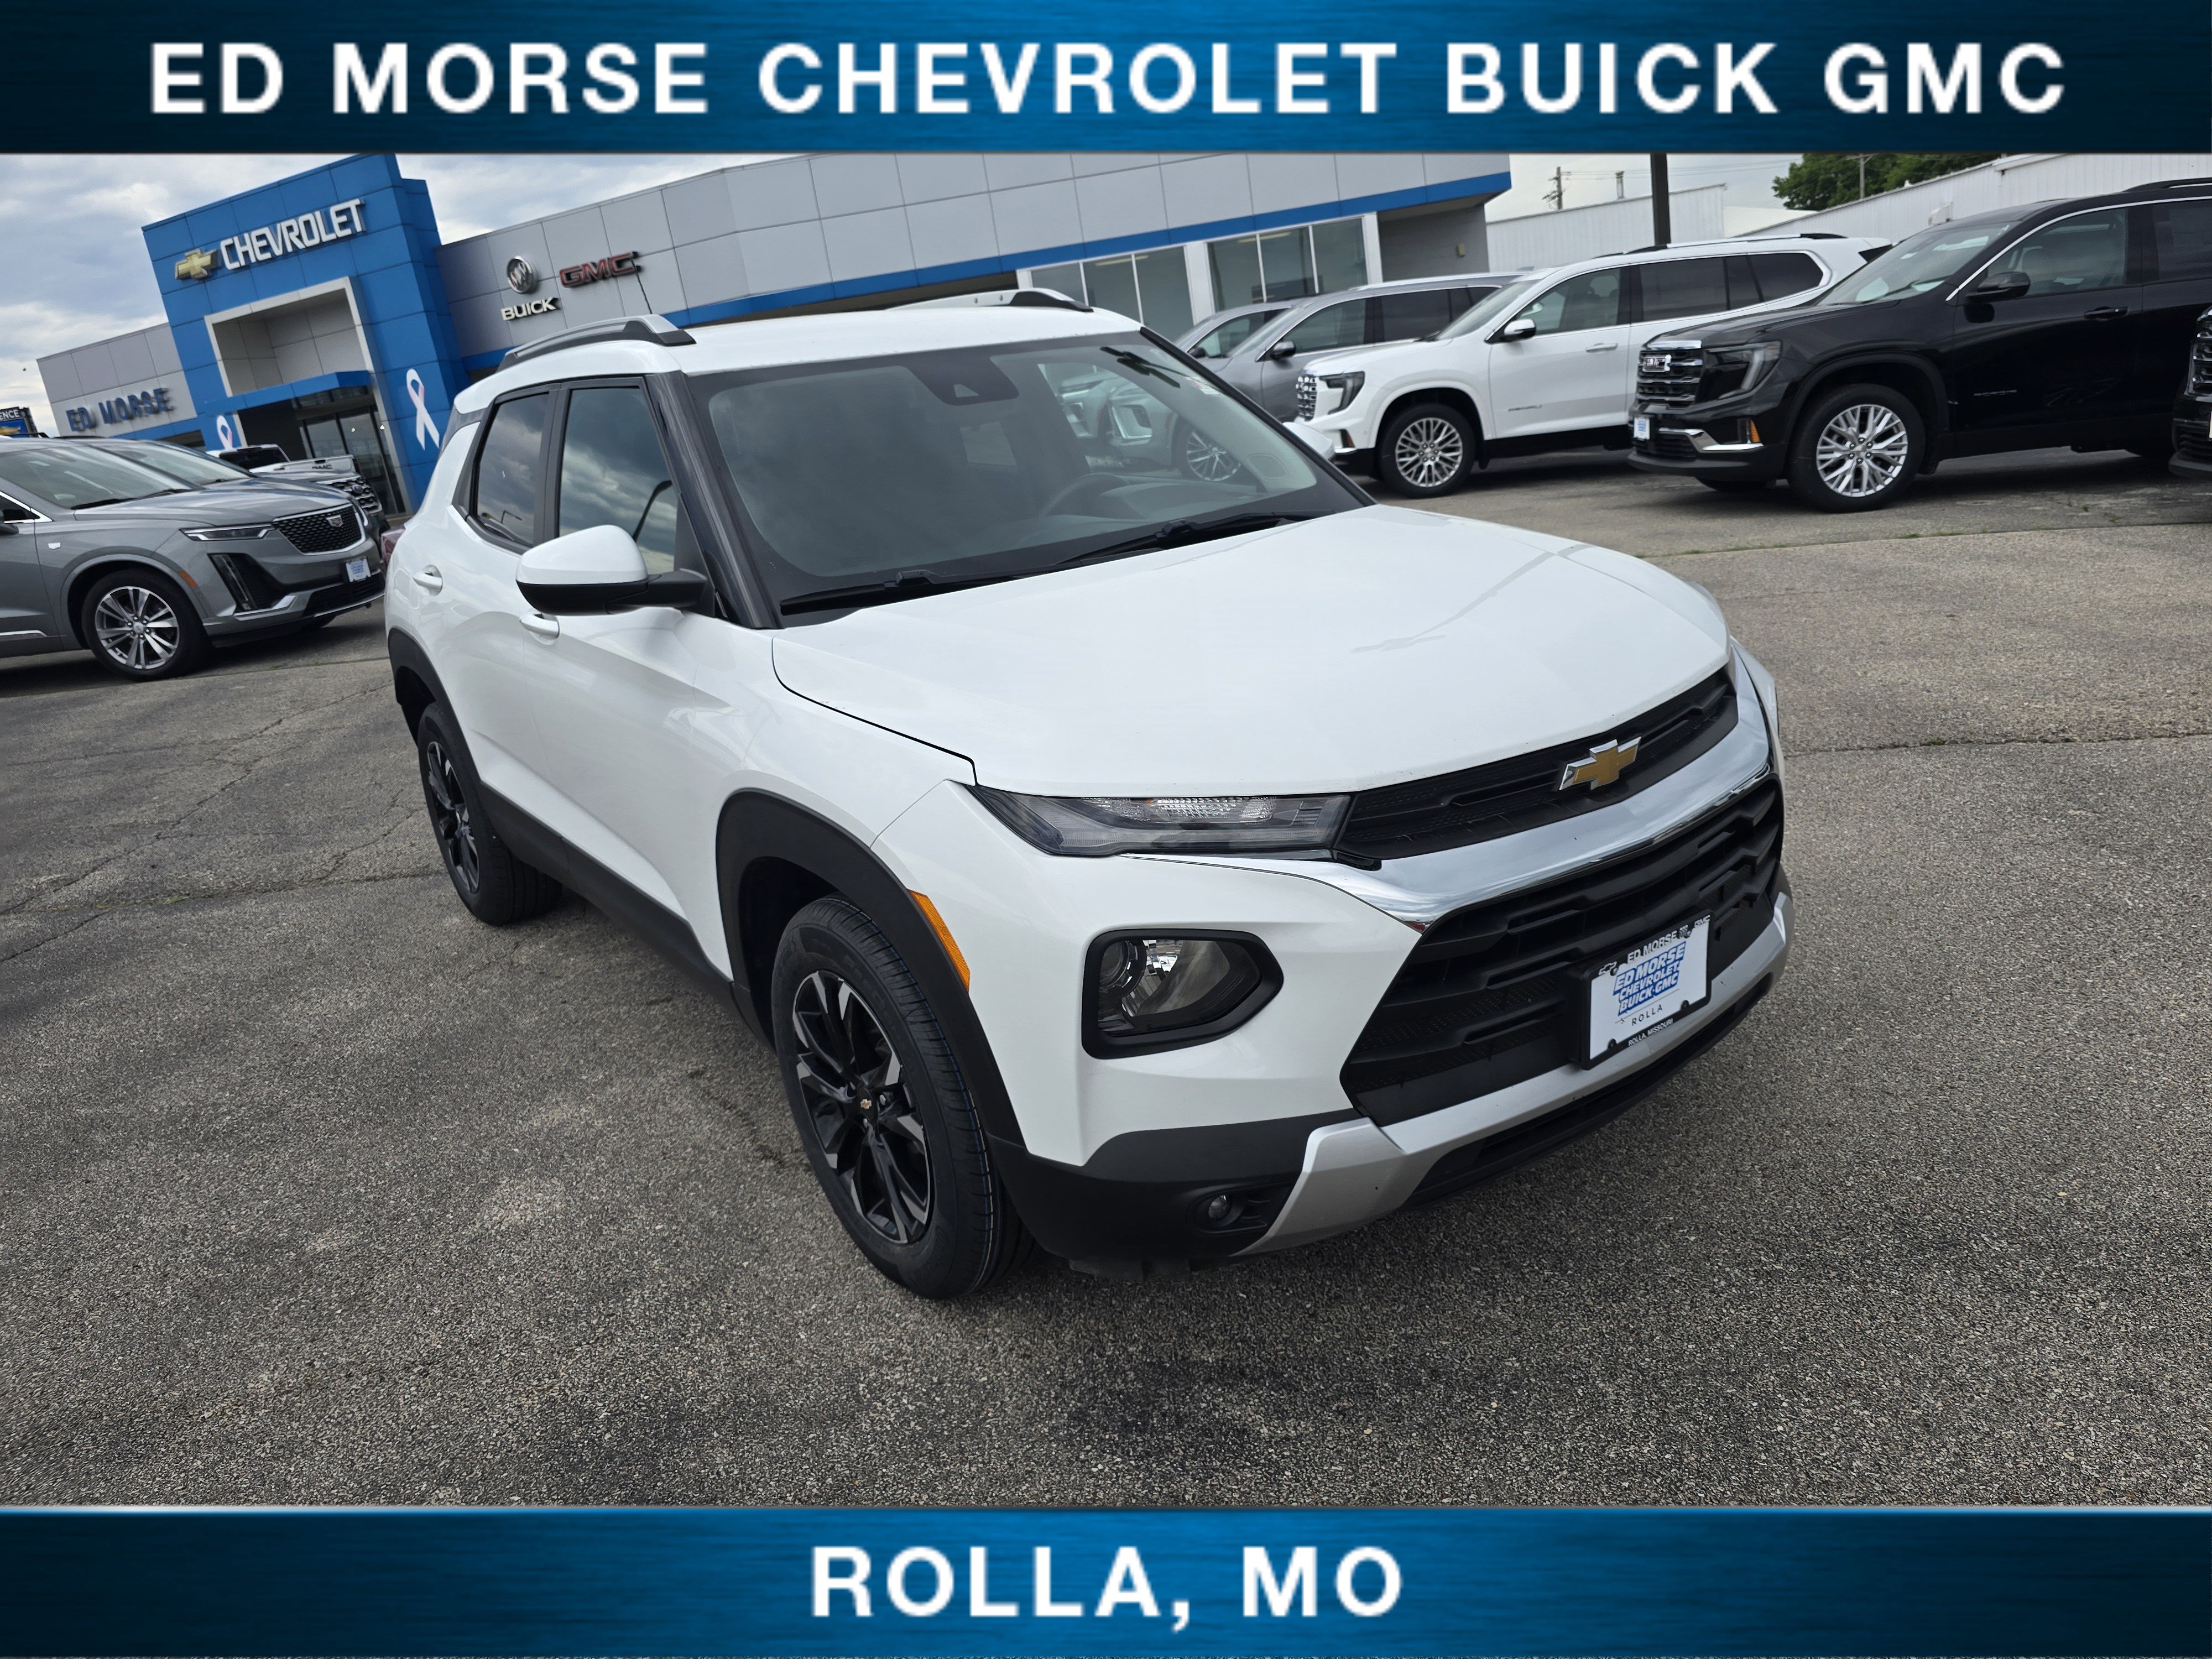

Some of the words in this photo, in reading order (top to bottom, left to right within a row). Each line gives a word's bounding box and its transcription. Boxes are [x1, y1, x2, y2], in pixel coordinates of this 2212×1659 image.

[220, 197, 363, 270] CHEVROLET
[559, 253, 635, 288] GMC
[500, 296, 556, 321] BUICK
[66, 406, 93, 431] ED
[98, 388, 171, 424] MORSE
[1627, 948, 1641, 964] ED
[1643, 930, 1678, 956] MORSE
[1614, 968, 1635, 992] ED
[1635, 942, 1686, 982] MORSE
[1619, 961, 1680, 1001] CHEVROLET
[1632, 1004, 1663, 1026] ROLLA
